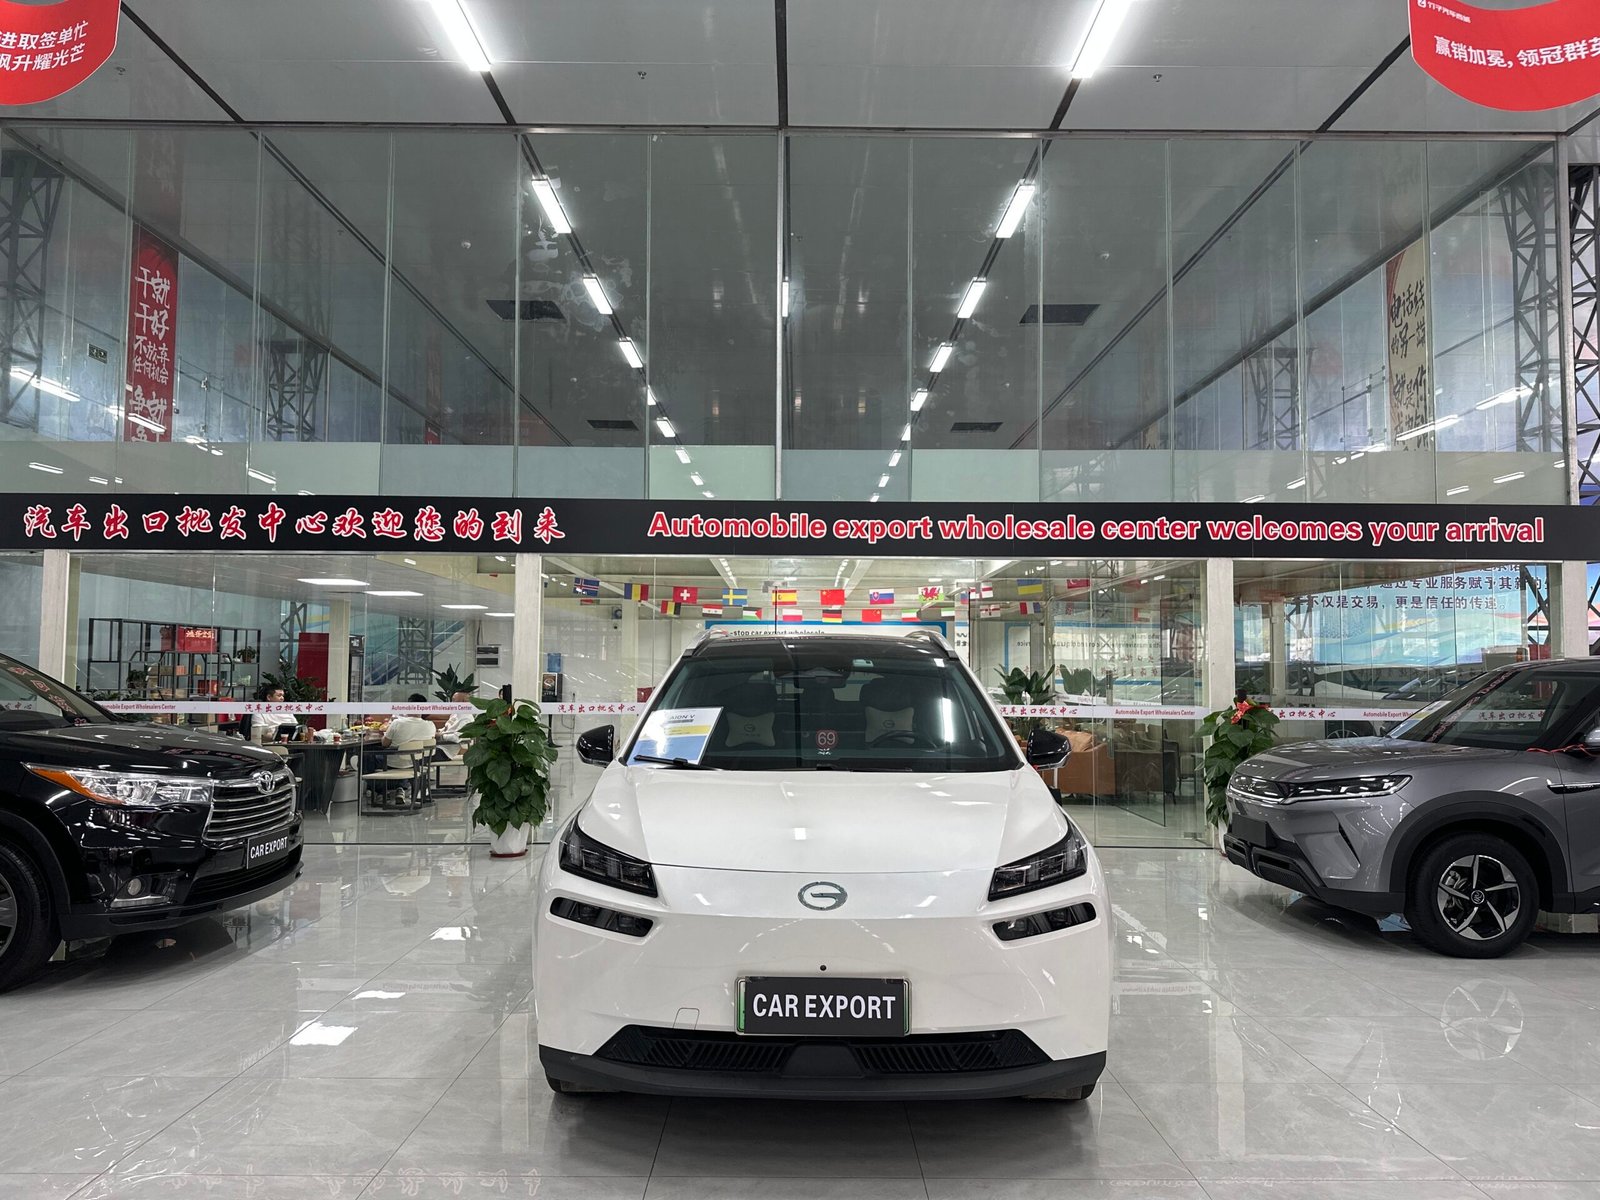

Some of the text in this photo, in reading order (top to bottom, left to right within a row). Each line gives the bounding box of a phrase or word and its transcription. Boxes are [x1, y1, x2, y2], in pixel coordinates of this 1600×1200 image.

[23, 503, 566, 543] 汽车出口批发中心欢迎您的到来
[647, 511, 1545, 547] Automobile export wholesale center welcomes your arrival
[245, 703, 324, 713] 汽车出口批发中心
[557, 703, 637, 714] 汽车出口批发中心
[1000, 706, 1078, 716] 汽车出口批发中心
[1271, 710, 1336, 719] 出口批发中心
[818, 731, 836, 746] 69
[250, 836, 288, 859] CAR EXPORT
[752, 993, 896, 1019] CAR EXPORT
